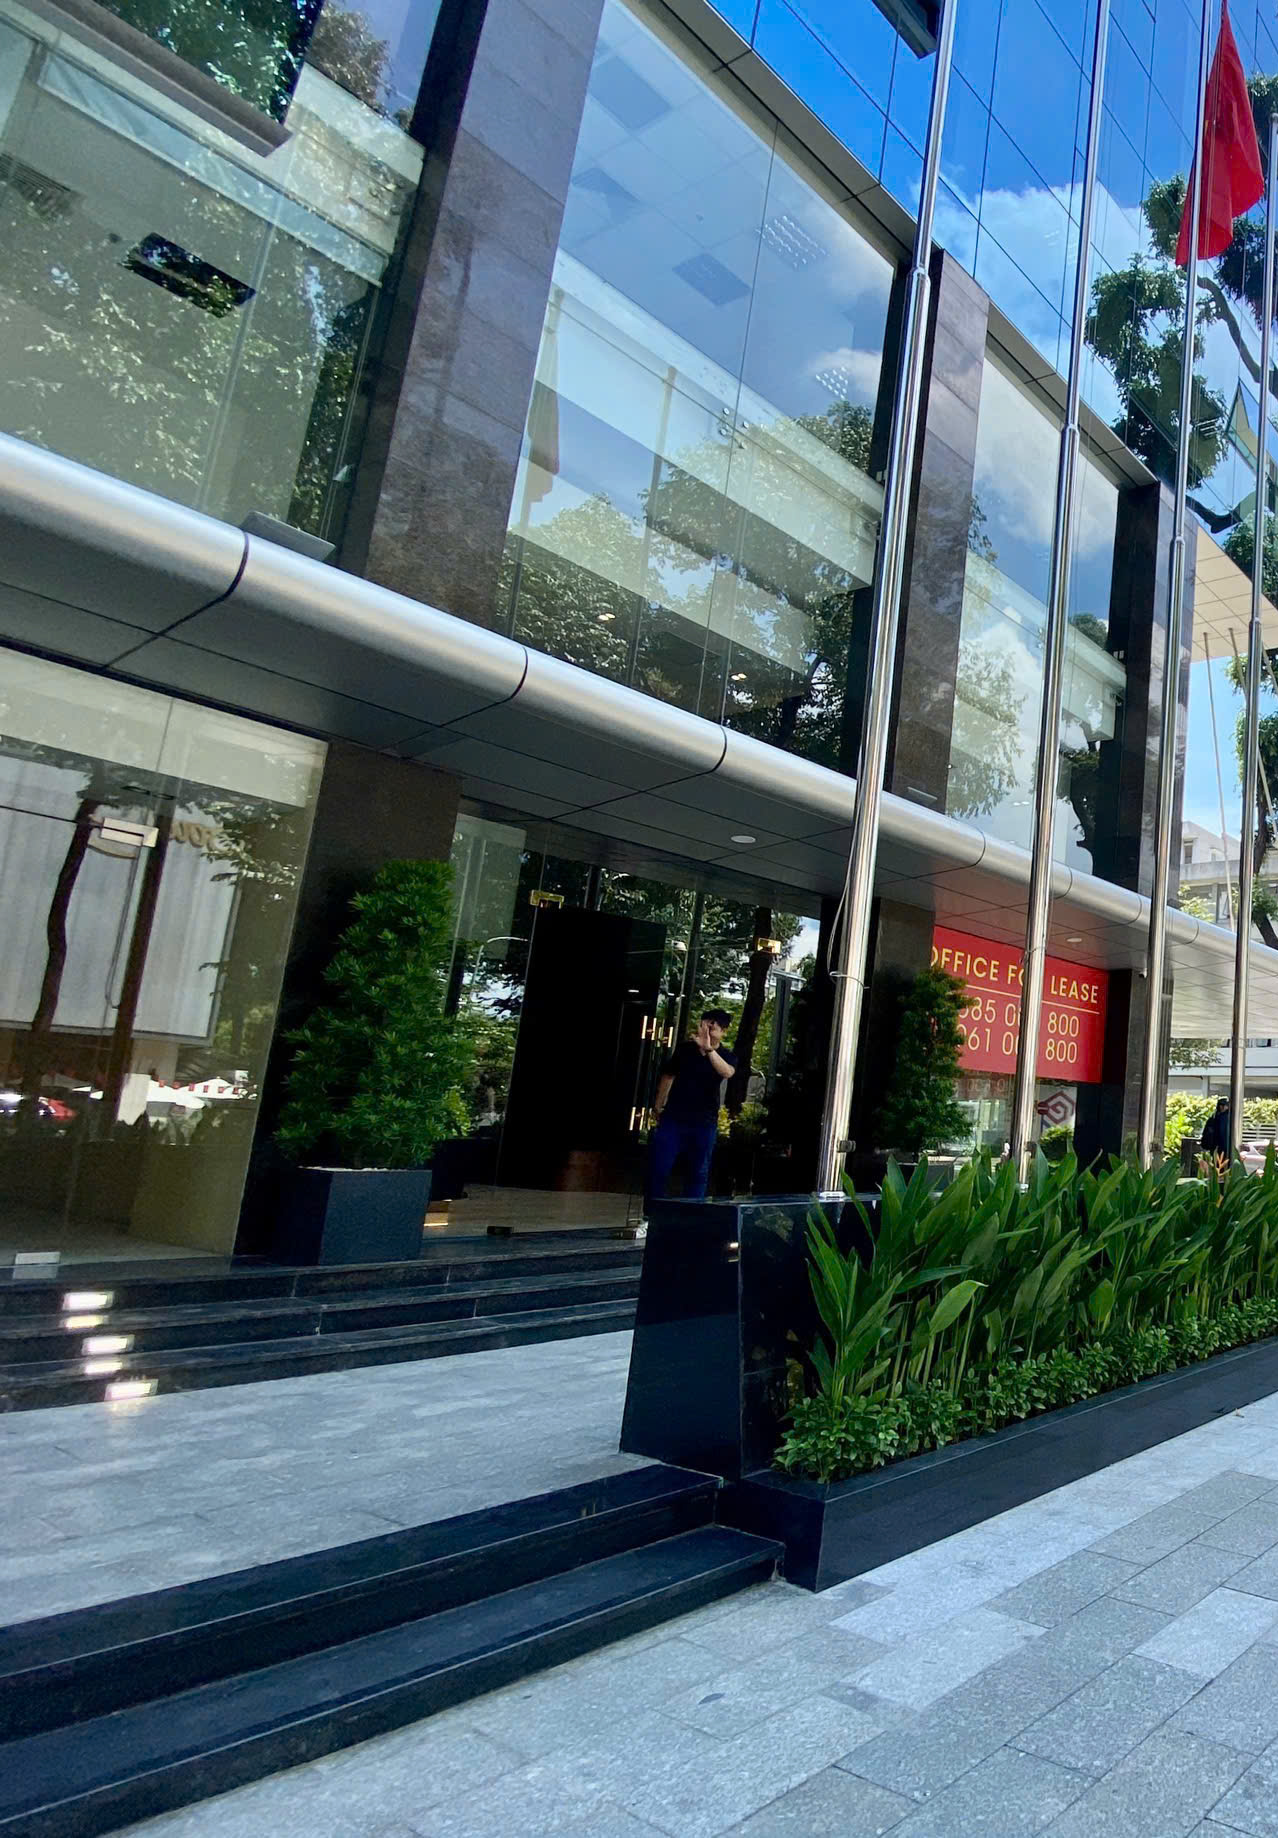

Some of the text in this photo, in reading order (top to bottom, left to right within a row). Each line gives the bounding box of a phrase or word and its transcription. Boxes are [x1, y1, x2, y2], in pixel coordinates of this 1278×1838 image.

[1050, 975, 1099, 1004] LEASE
[1047, 1011, 1080, 1038] 800
[1045, 1038, 1078, 1064] 800
